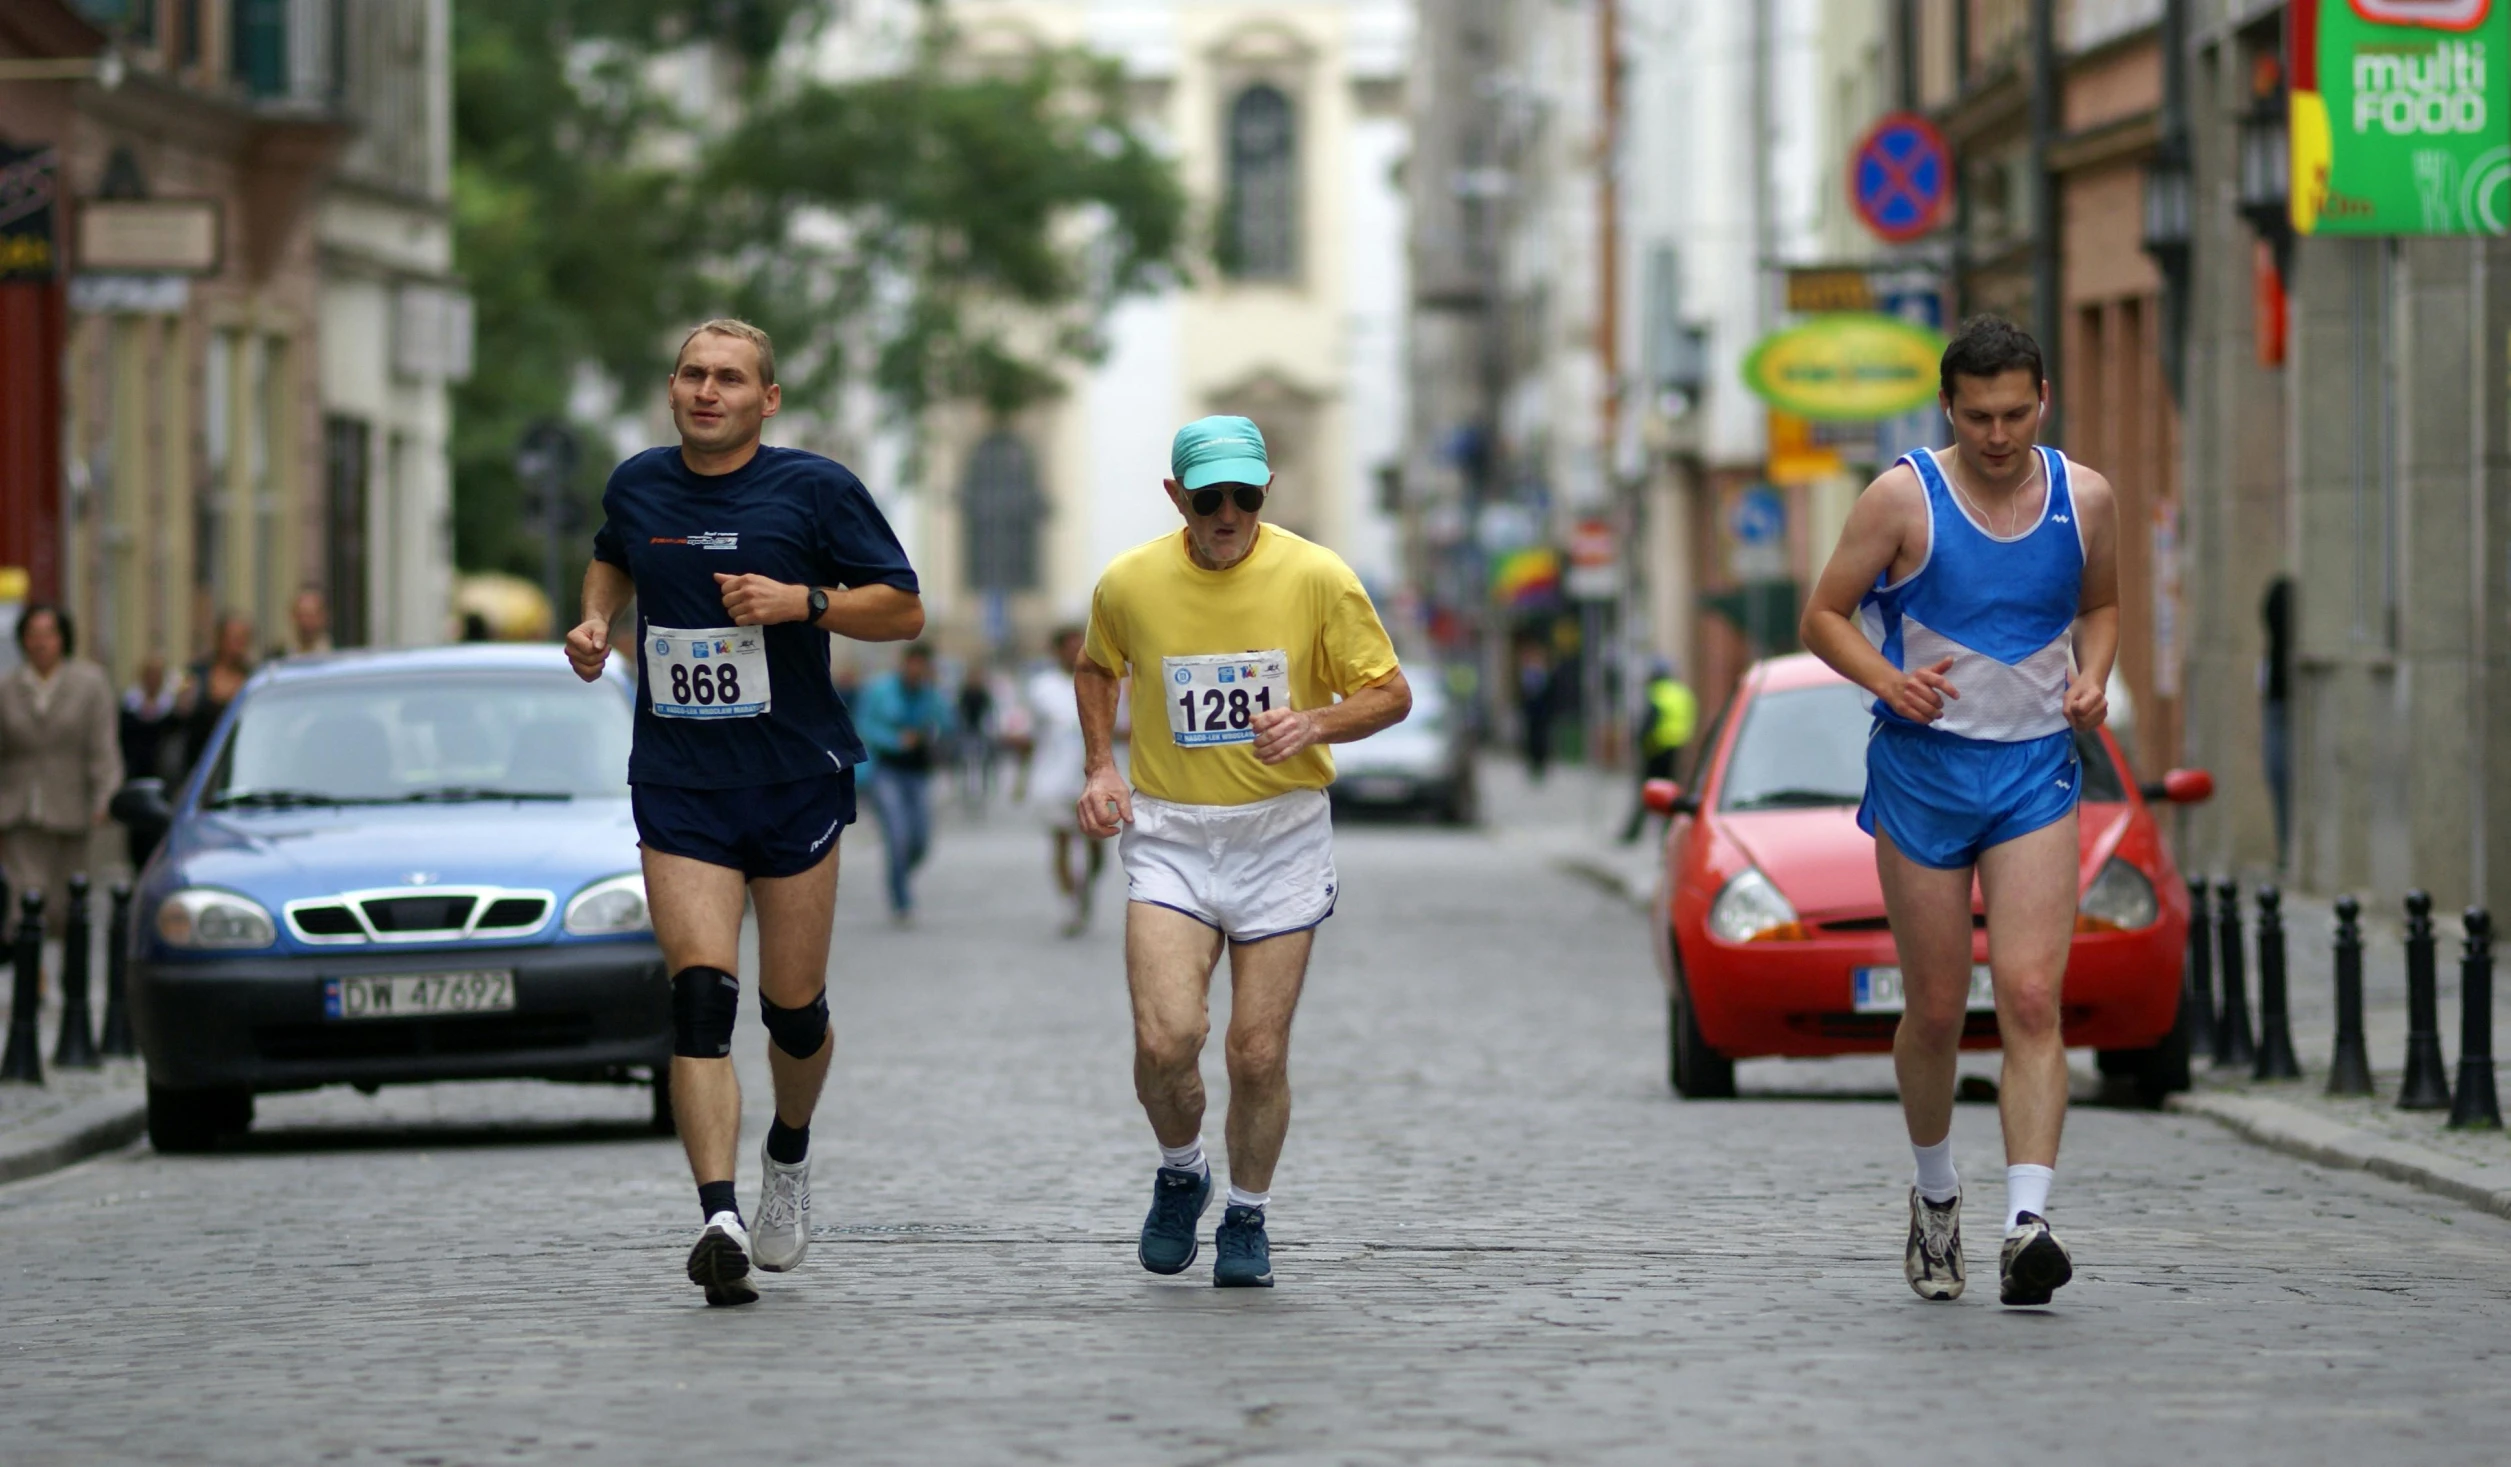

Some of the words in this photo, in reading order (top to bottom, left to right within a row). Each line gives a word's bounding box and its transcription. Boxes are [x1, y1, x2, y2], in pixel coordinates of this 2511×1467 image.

[2354, 40, 2486, 96] multi
[2354, 92, 2487, 135] FOOD
[671, 662, 741, 706] 868
[1179, 686, 1271, 732] 1281
[344, 977, 393, 1017] DW
[410, 971, 508, 1012] 47692
